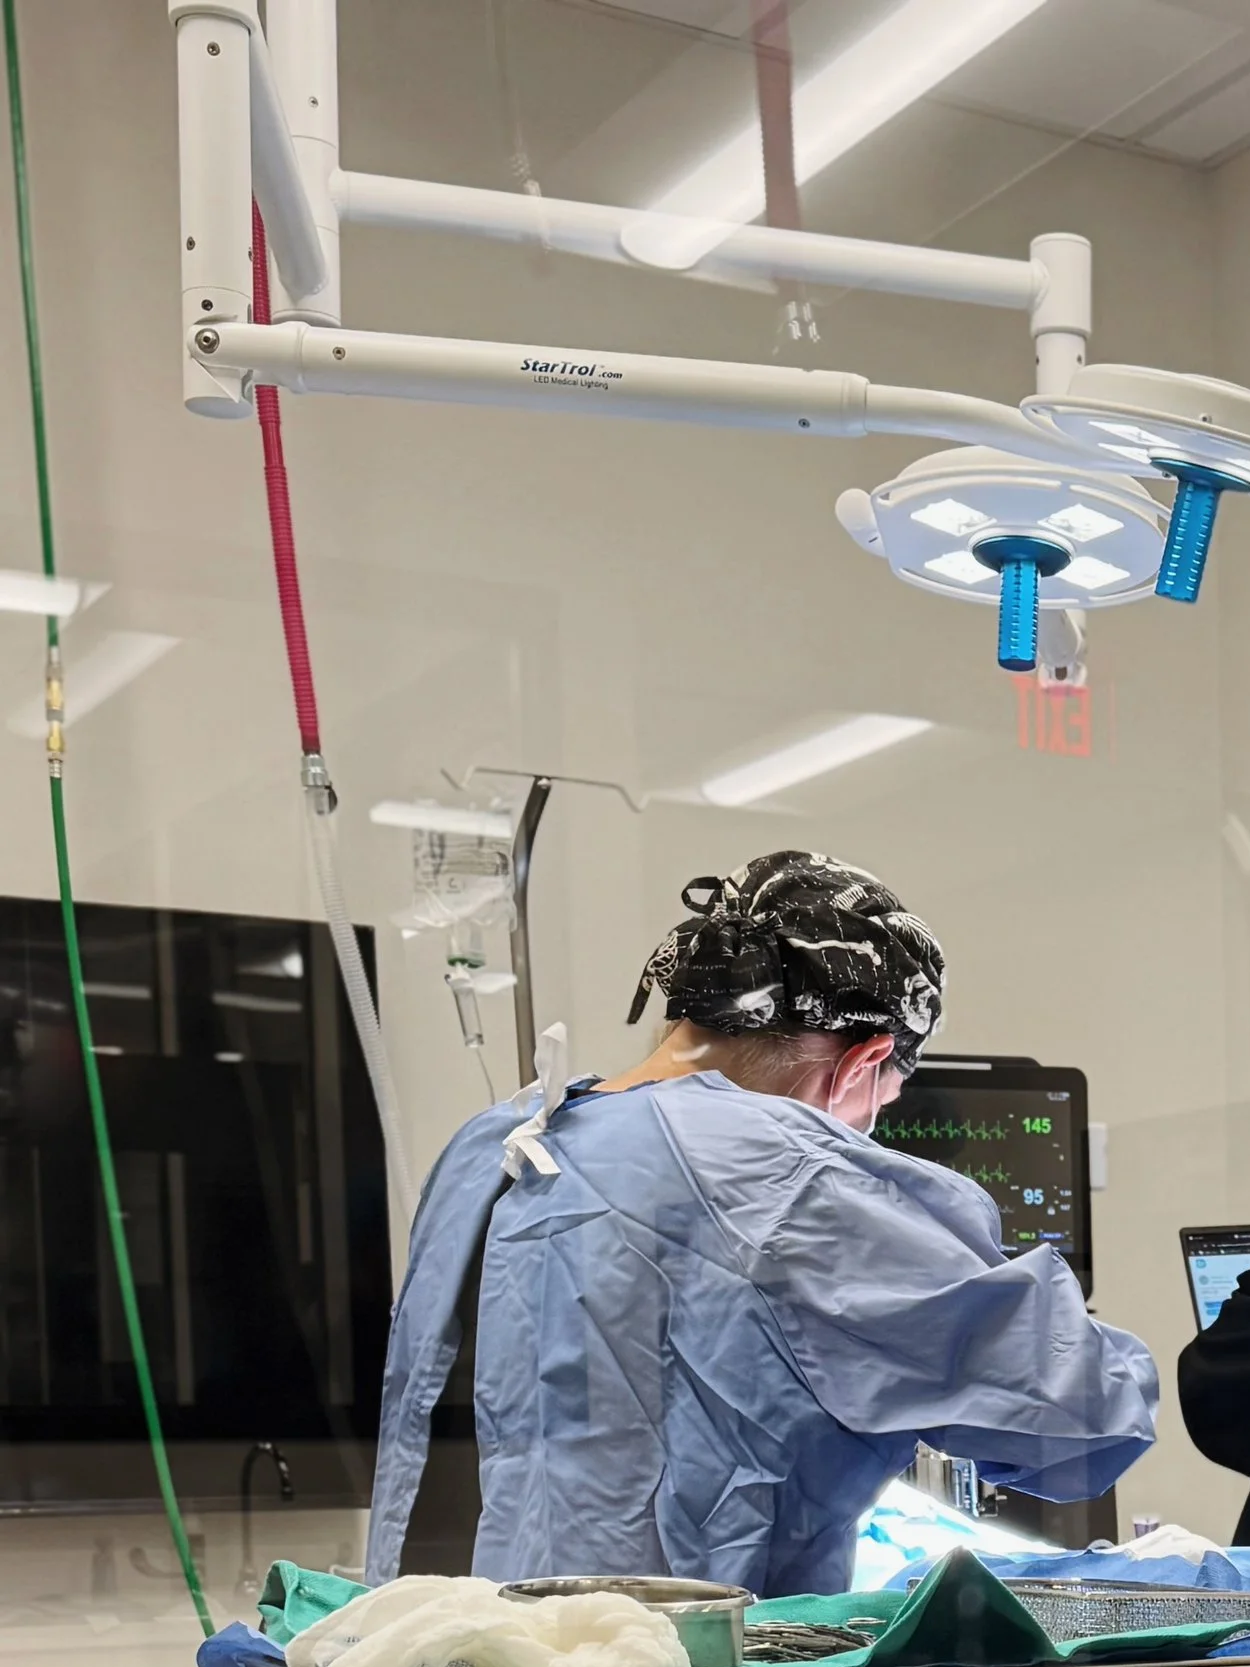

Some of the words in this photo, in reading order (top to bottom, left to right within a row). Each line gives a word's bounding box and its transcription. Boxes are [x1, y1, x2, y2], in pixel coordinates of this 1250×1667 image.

[533, 375, 550, 384] LED
[551, 377, 579, 386] Medical
[580, 379, 609, 390] Lighting
[1022, 1117, 1052, 1134] 145
[1023, 1188, 1045, 1206] 95
